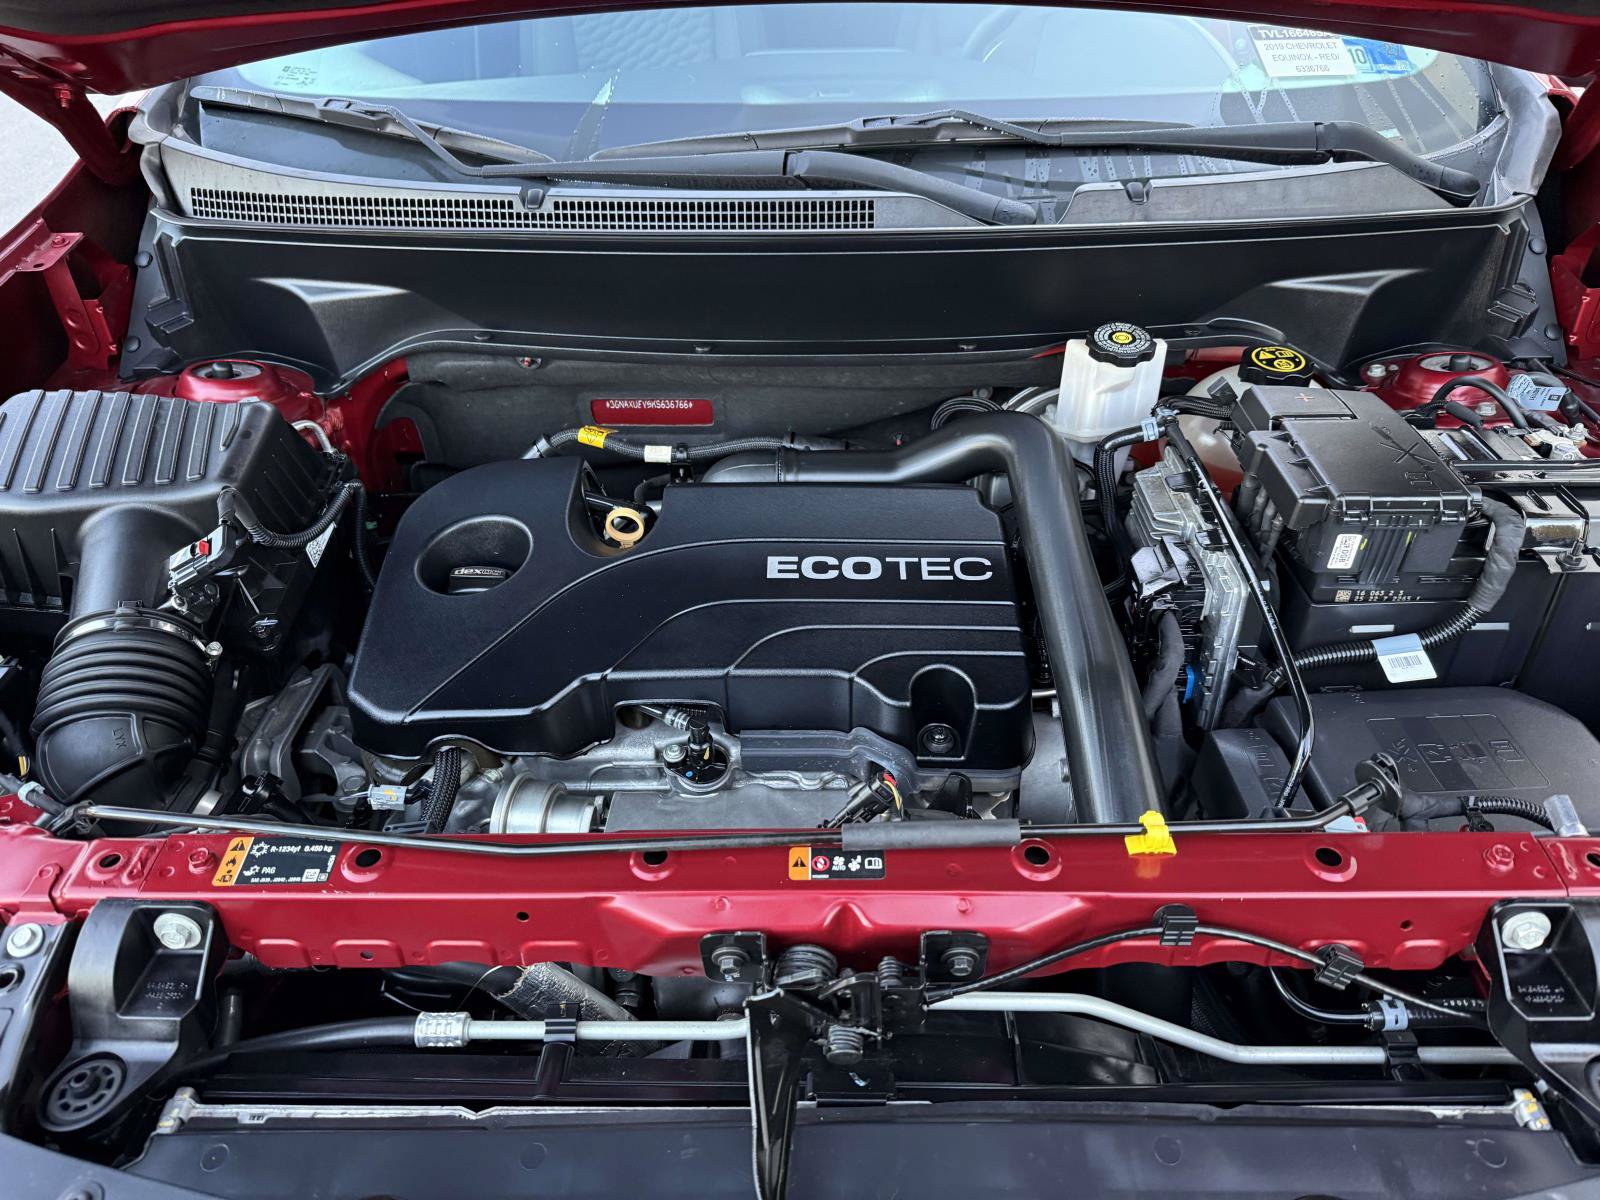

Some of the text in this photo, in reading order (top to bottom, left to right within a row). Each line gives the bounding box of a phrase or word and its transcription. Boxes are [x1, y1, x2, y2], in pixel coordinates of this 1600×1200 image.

[1285, 41, 1338, 50] CHEVROLET
[1272, 53, 1312, 62] EQUINOX
[766, 555, 993, 581] ECOTEC
[270, 845, 302, 854] R-1234yf
[323, 844, 333, 853] kg
[261, 866, 276, 874] PAG
[832, 864, 847, 872] AUTO
